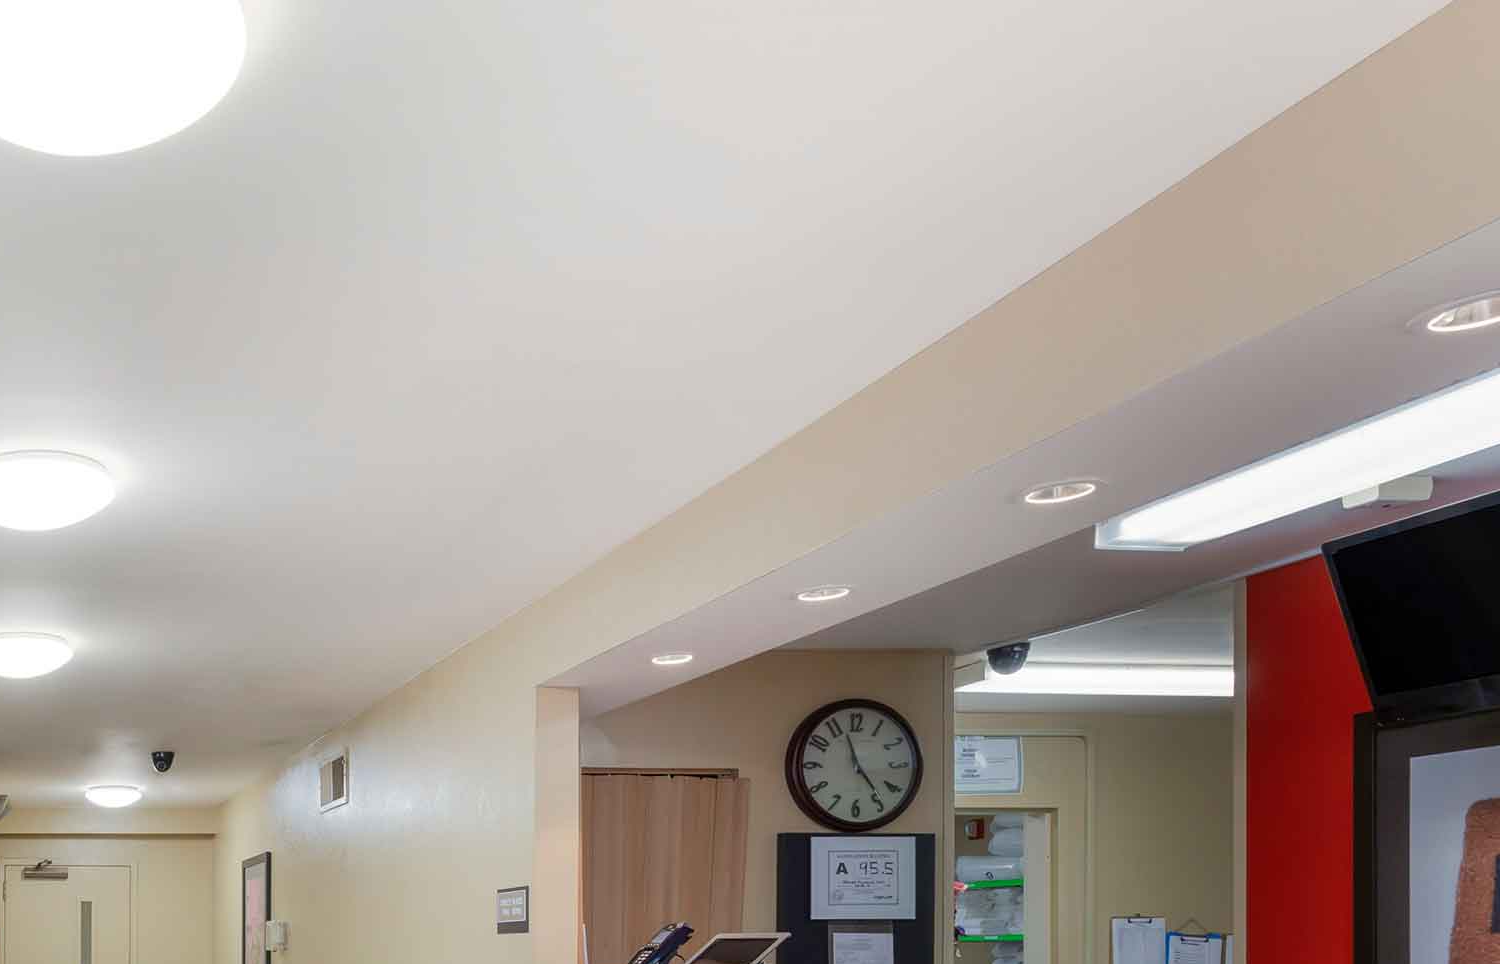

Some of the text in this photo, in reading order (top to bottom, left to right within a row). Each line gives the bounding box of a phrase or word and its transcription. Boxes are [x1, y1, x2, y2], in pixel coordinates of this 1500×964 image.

[825, 717, 844, 738] 11
[849, 712, 864, 733] 12
[871, 719, 884, 737] 1
[808, 734, 830, 753] 10
[884, 737, 903, 751] 2
[802, 760, 823, 770] 9
[887, 760, 909, 769] 3
[810, 780, 829, 793] 8
[883, 780, 902, 793] 4
[827, 793, 842, 812] 7
[851, 799, 861, 818] 6
[871, 792, 885, 813] 5
[835, 862, 849, 875] A
